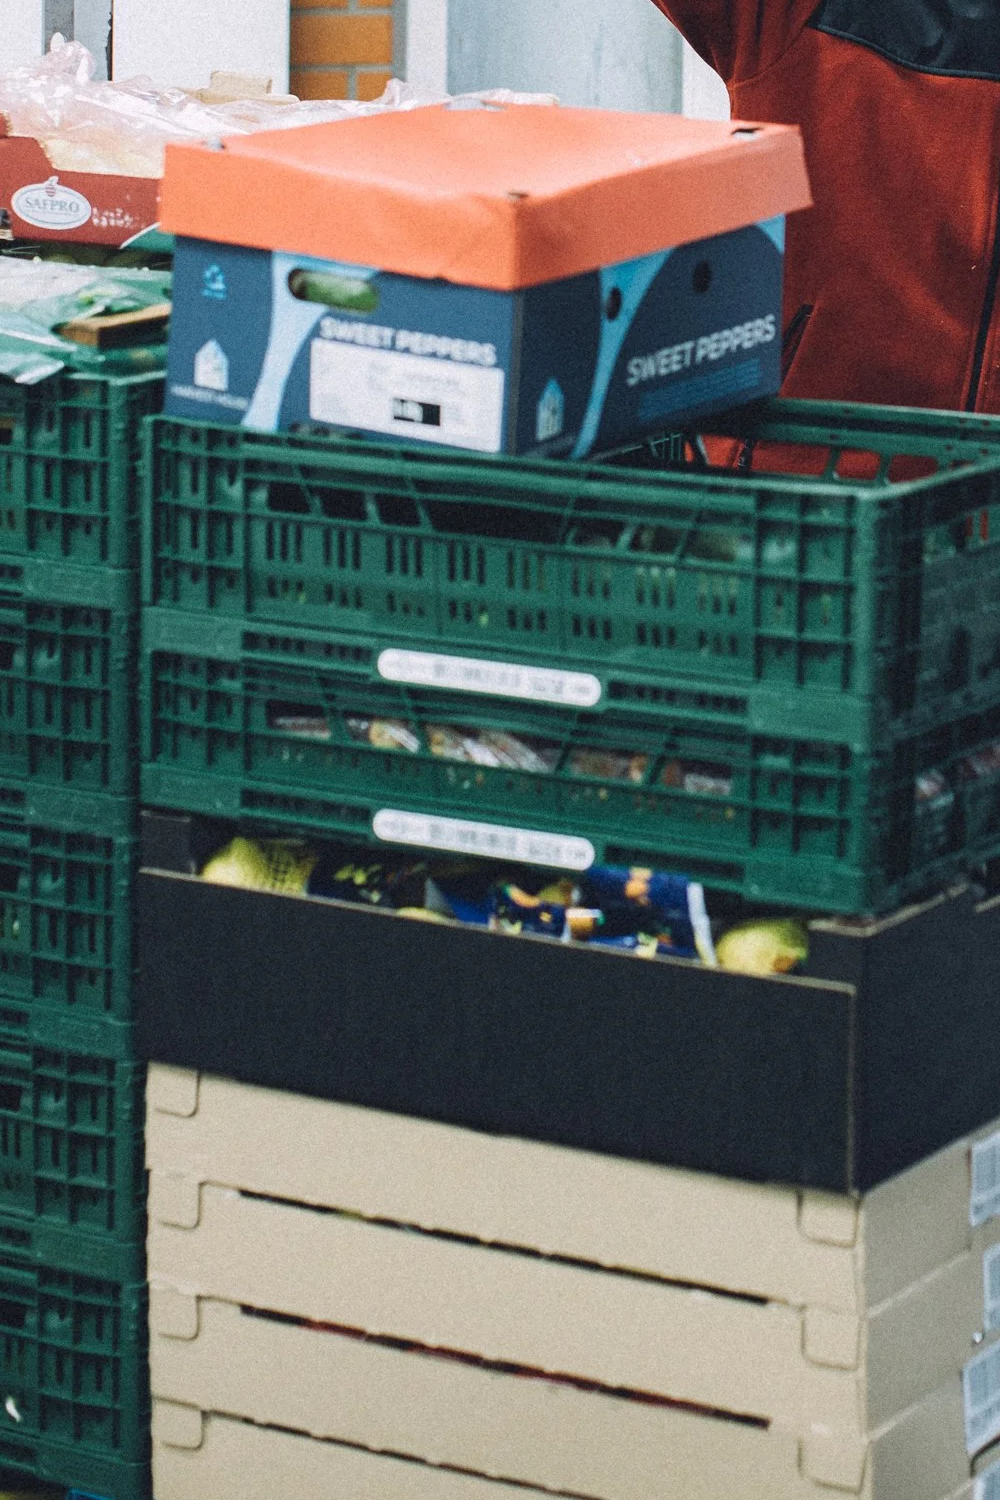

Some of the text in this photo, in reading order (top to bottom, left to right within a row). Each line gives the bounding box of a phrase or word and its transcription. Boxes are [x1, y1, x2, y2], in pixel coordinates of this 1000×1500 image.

[24, 196, 80, 213] SAFPRO
[319, 315, 498, 367] SWEET PEPPERS
[625, 313, 777, 387] SWEET PEPPERS
